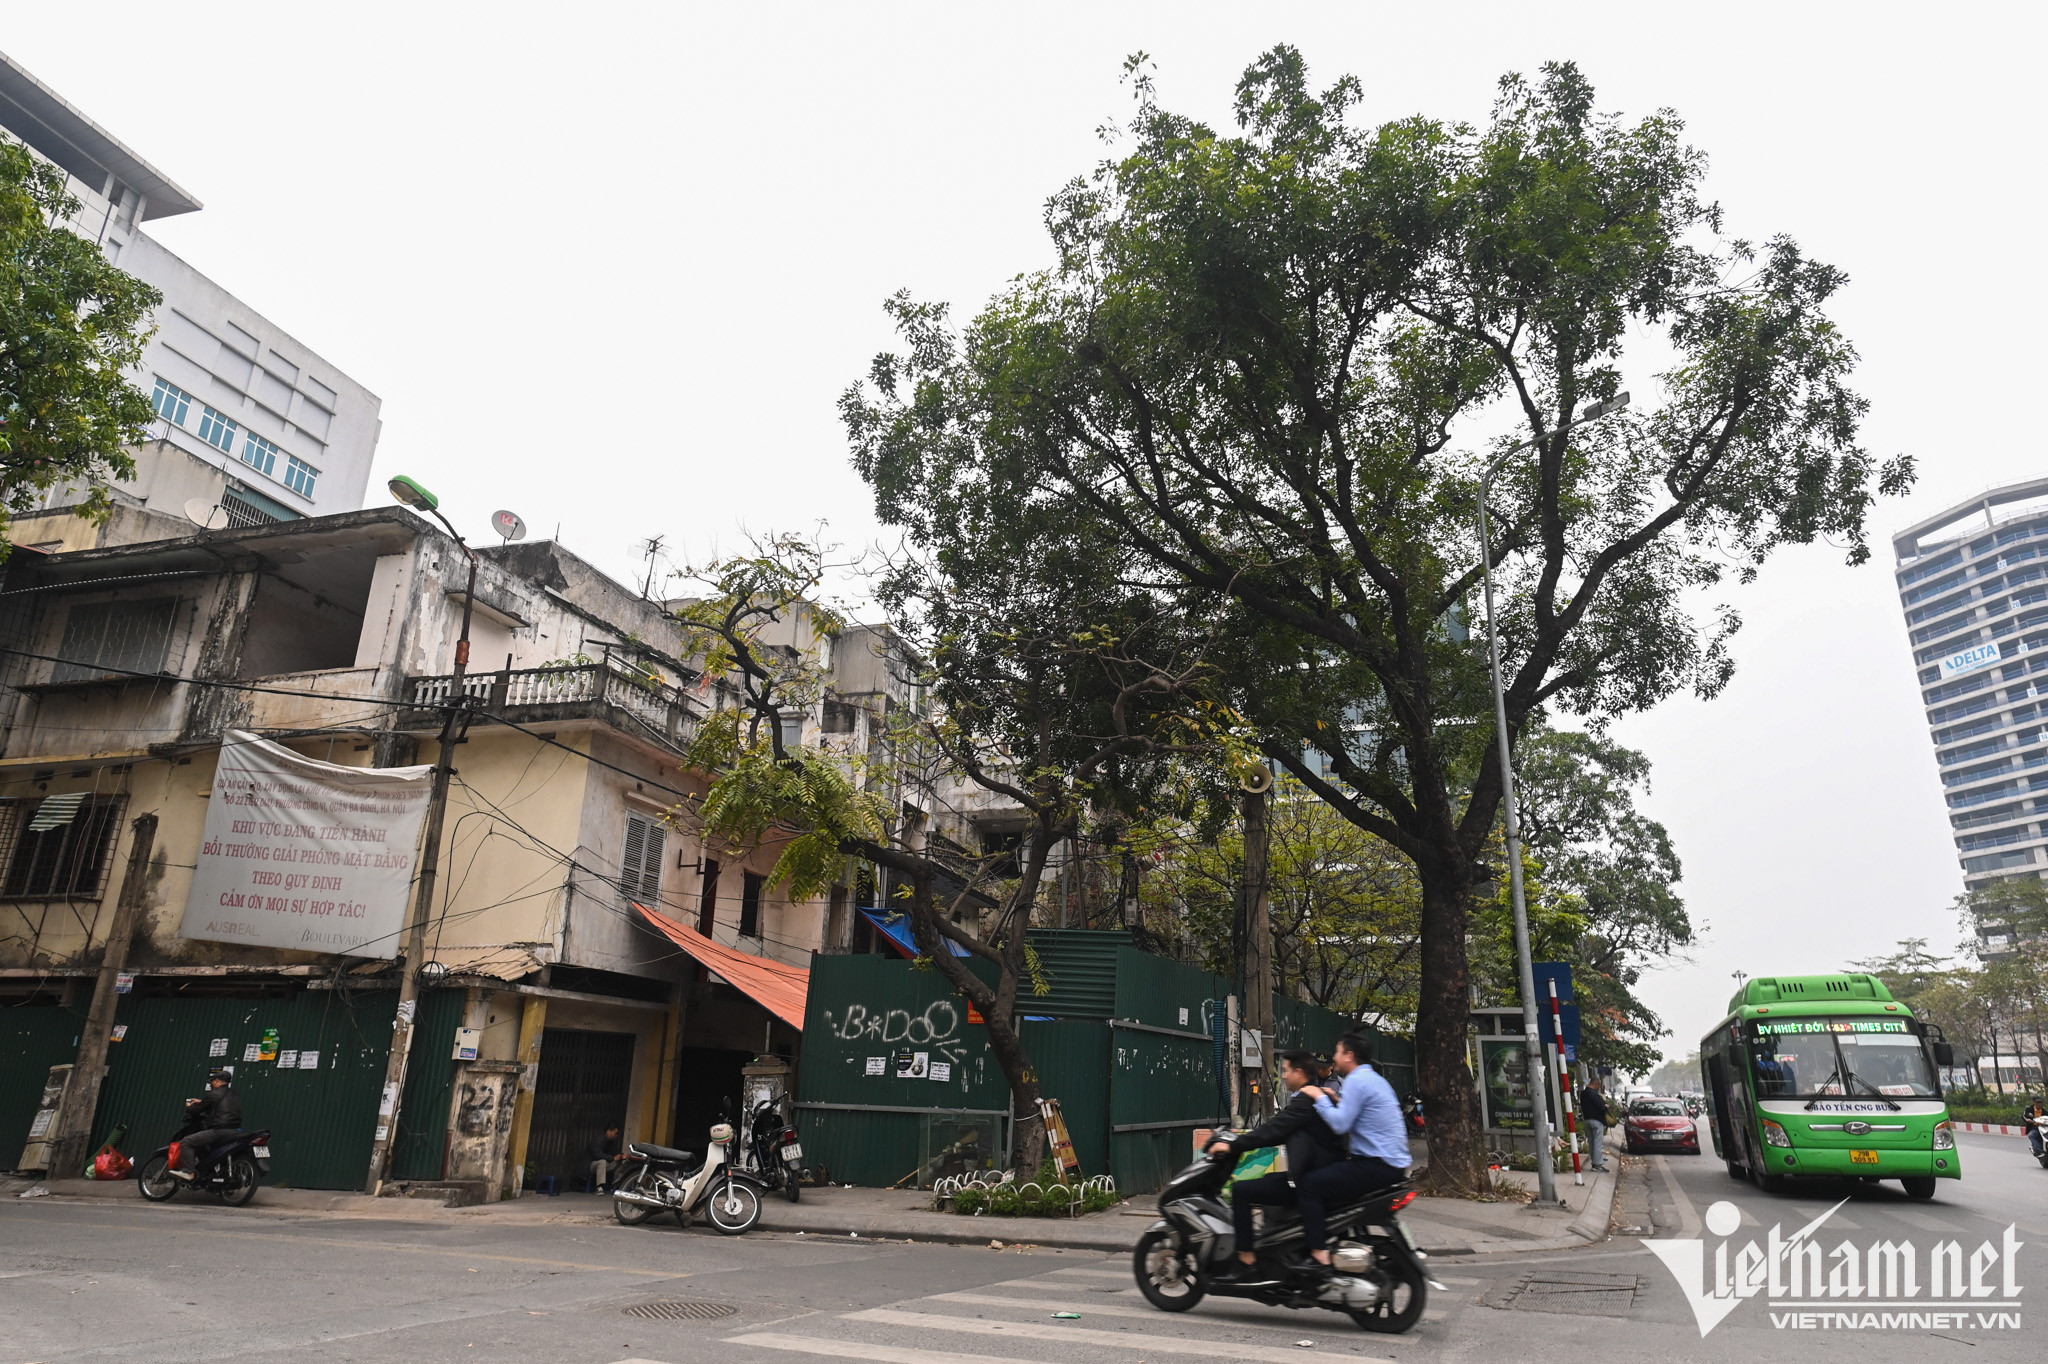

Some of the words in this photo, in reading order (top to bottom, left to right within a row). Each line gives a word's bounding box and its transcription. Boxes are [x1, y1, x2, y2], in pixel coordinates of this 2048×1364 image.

[1953, 645, 1996, 668] DELTA
[236, 797, 244, 805] 22
[349, 803, 358, 812] BA
[232, 820, 256, 834] KHU
[259, 820, 281, 839] VỰC
[284, 824, 315, 839] ĐANG
[320, 821, 350, 840] TIẾN
[351, 825, 387, 842] HÀNH
[225, 842, 269, 860] THƯỜNG
[273, 844, 298, 862] GIẢI
[301, 847, 340, 865] PHÓNG
[343, 849, 371, 870] MẶT
[252, 870, 282, 886] THEO
[284, 873, 310, 890] QUY
[312, 876, 343, 893] ĐỊNH
[220, 888, 244, 908] CẢM
[247, 893, 263, 910] ƠN
[265, 896, 288, 914] MỌI
[291, 898, 308, 917] SỰ
[309, 900, 335, 919] HỢP
[338, 899, 366, 919] TÁC!
[1757, 1023, 1771, 1035] BV
[1850, 1022, 1881, 1033] TIMES
[1884, 1020, 1907, 1033] CITY
